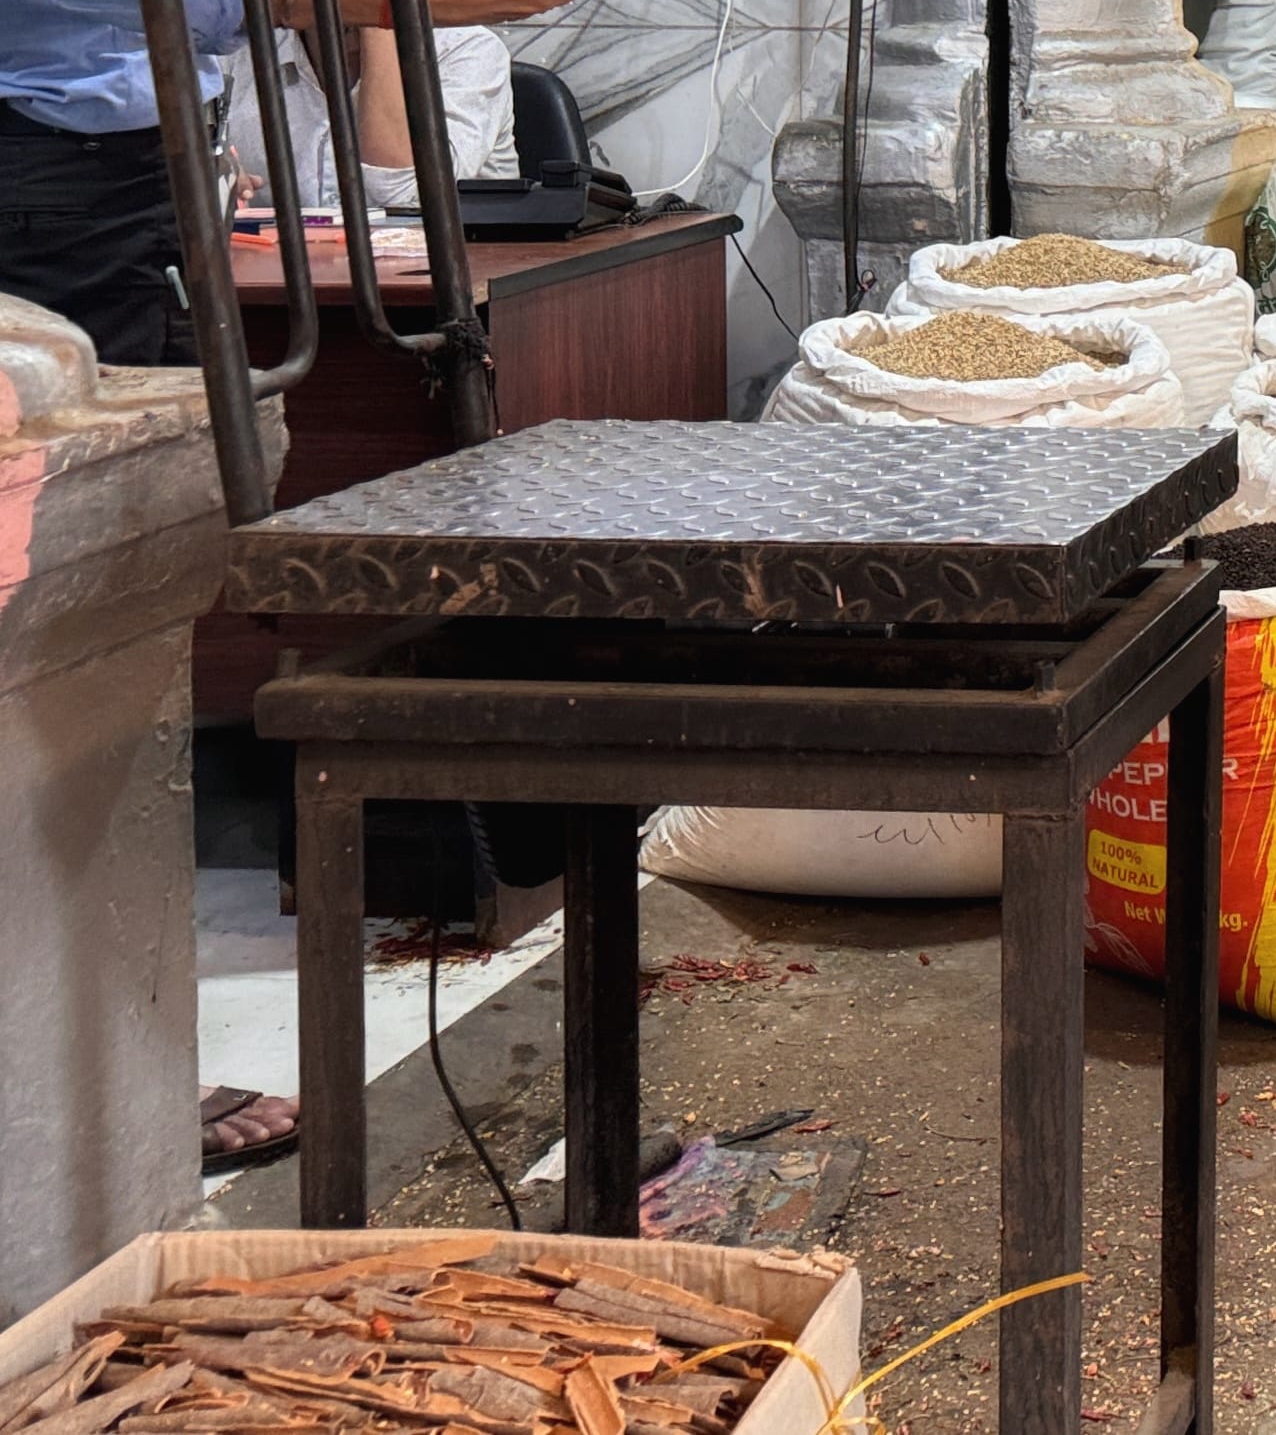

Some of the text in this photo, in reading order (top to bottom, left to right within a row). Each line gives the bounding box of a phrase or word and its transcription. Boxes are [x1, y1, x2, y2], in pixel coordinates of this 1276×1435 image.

[1100, 840, 1143, 866] 100%
[1091, 858, 1160, 890] NATURAL
[1124, 900, 1151, 923] Net
